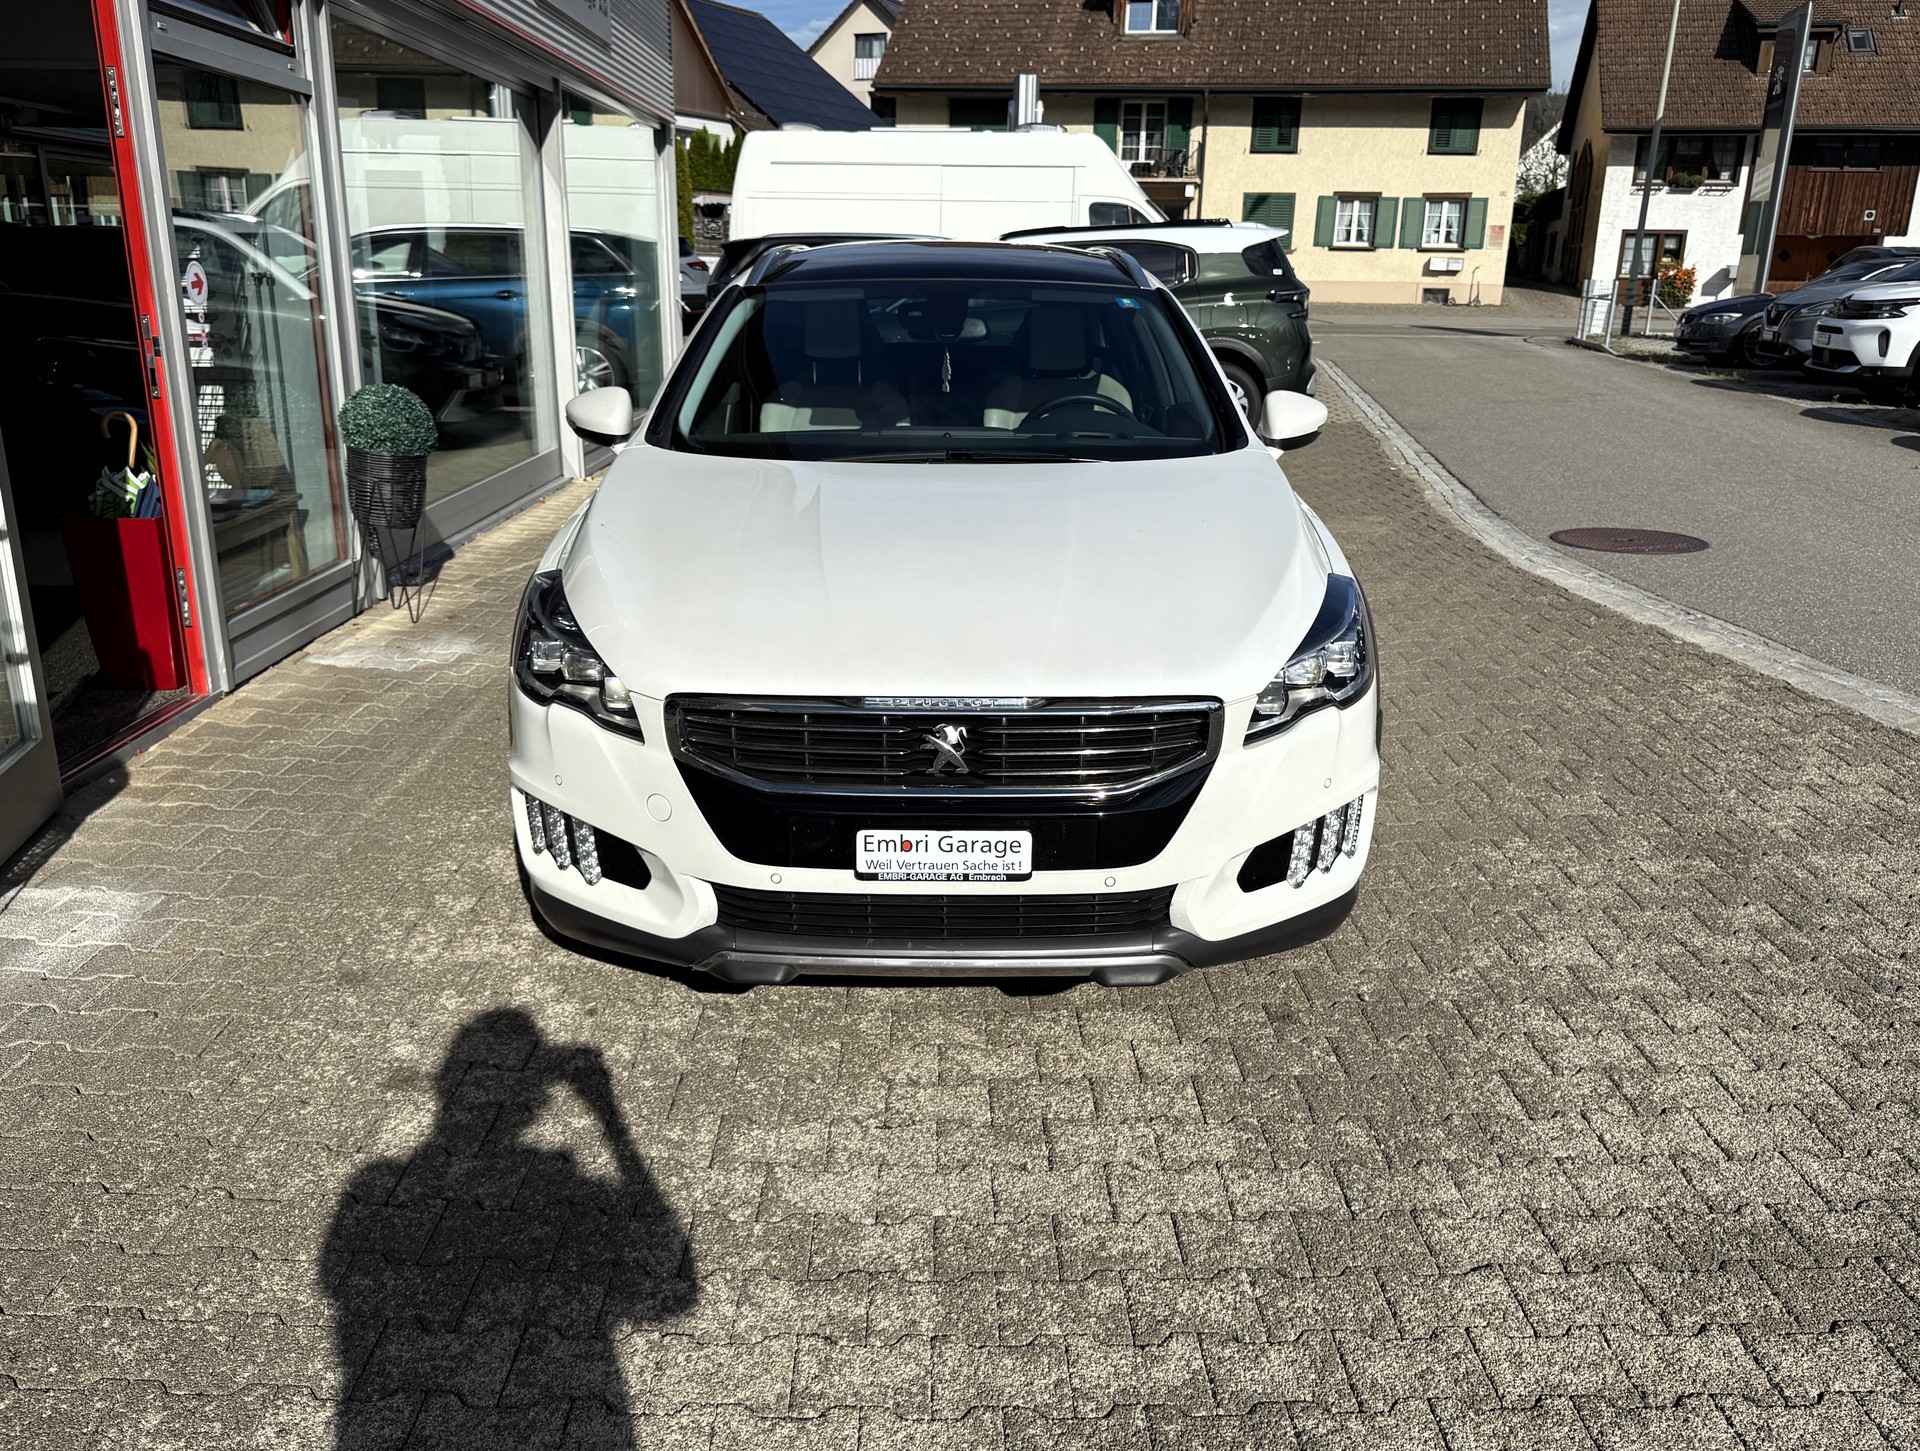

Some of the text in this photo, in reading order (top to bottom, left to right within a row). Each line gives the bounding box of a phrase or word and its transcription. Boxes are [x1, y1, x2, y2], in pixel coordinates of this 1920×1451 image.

[891, 698, 998, 707] PEUGEOT
[863, 834, 1022, 858] Embri Garage
[865, 859, 892, 870] Weil
[897, 860, 959, 871] Vertrauen
[962, 860, 998, 871] Sache
[878, 873, 1007, 881] EMBRI-GARAGE AG Embrach
